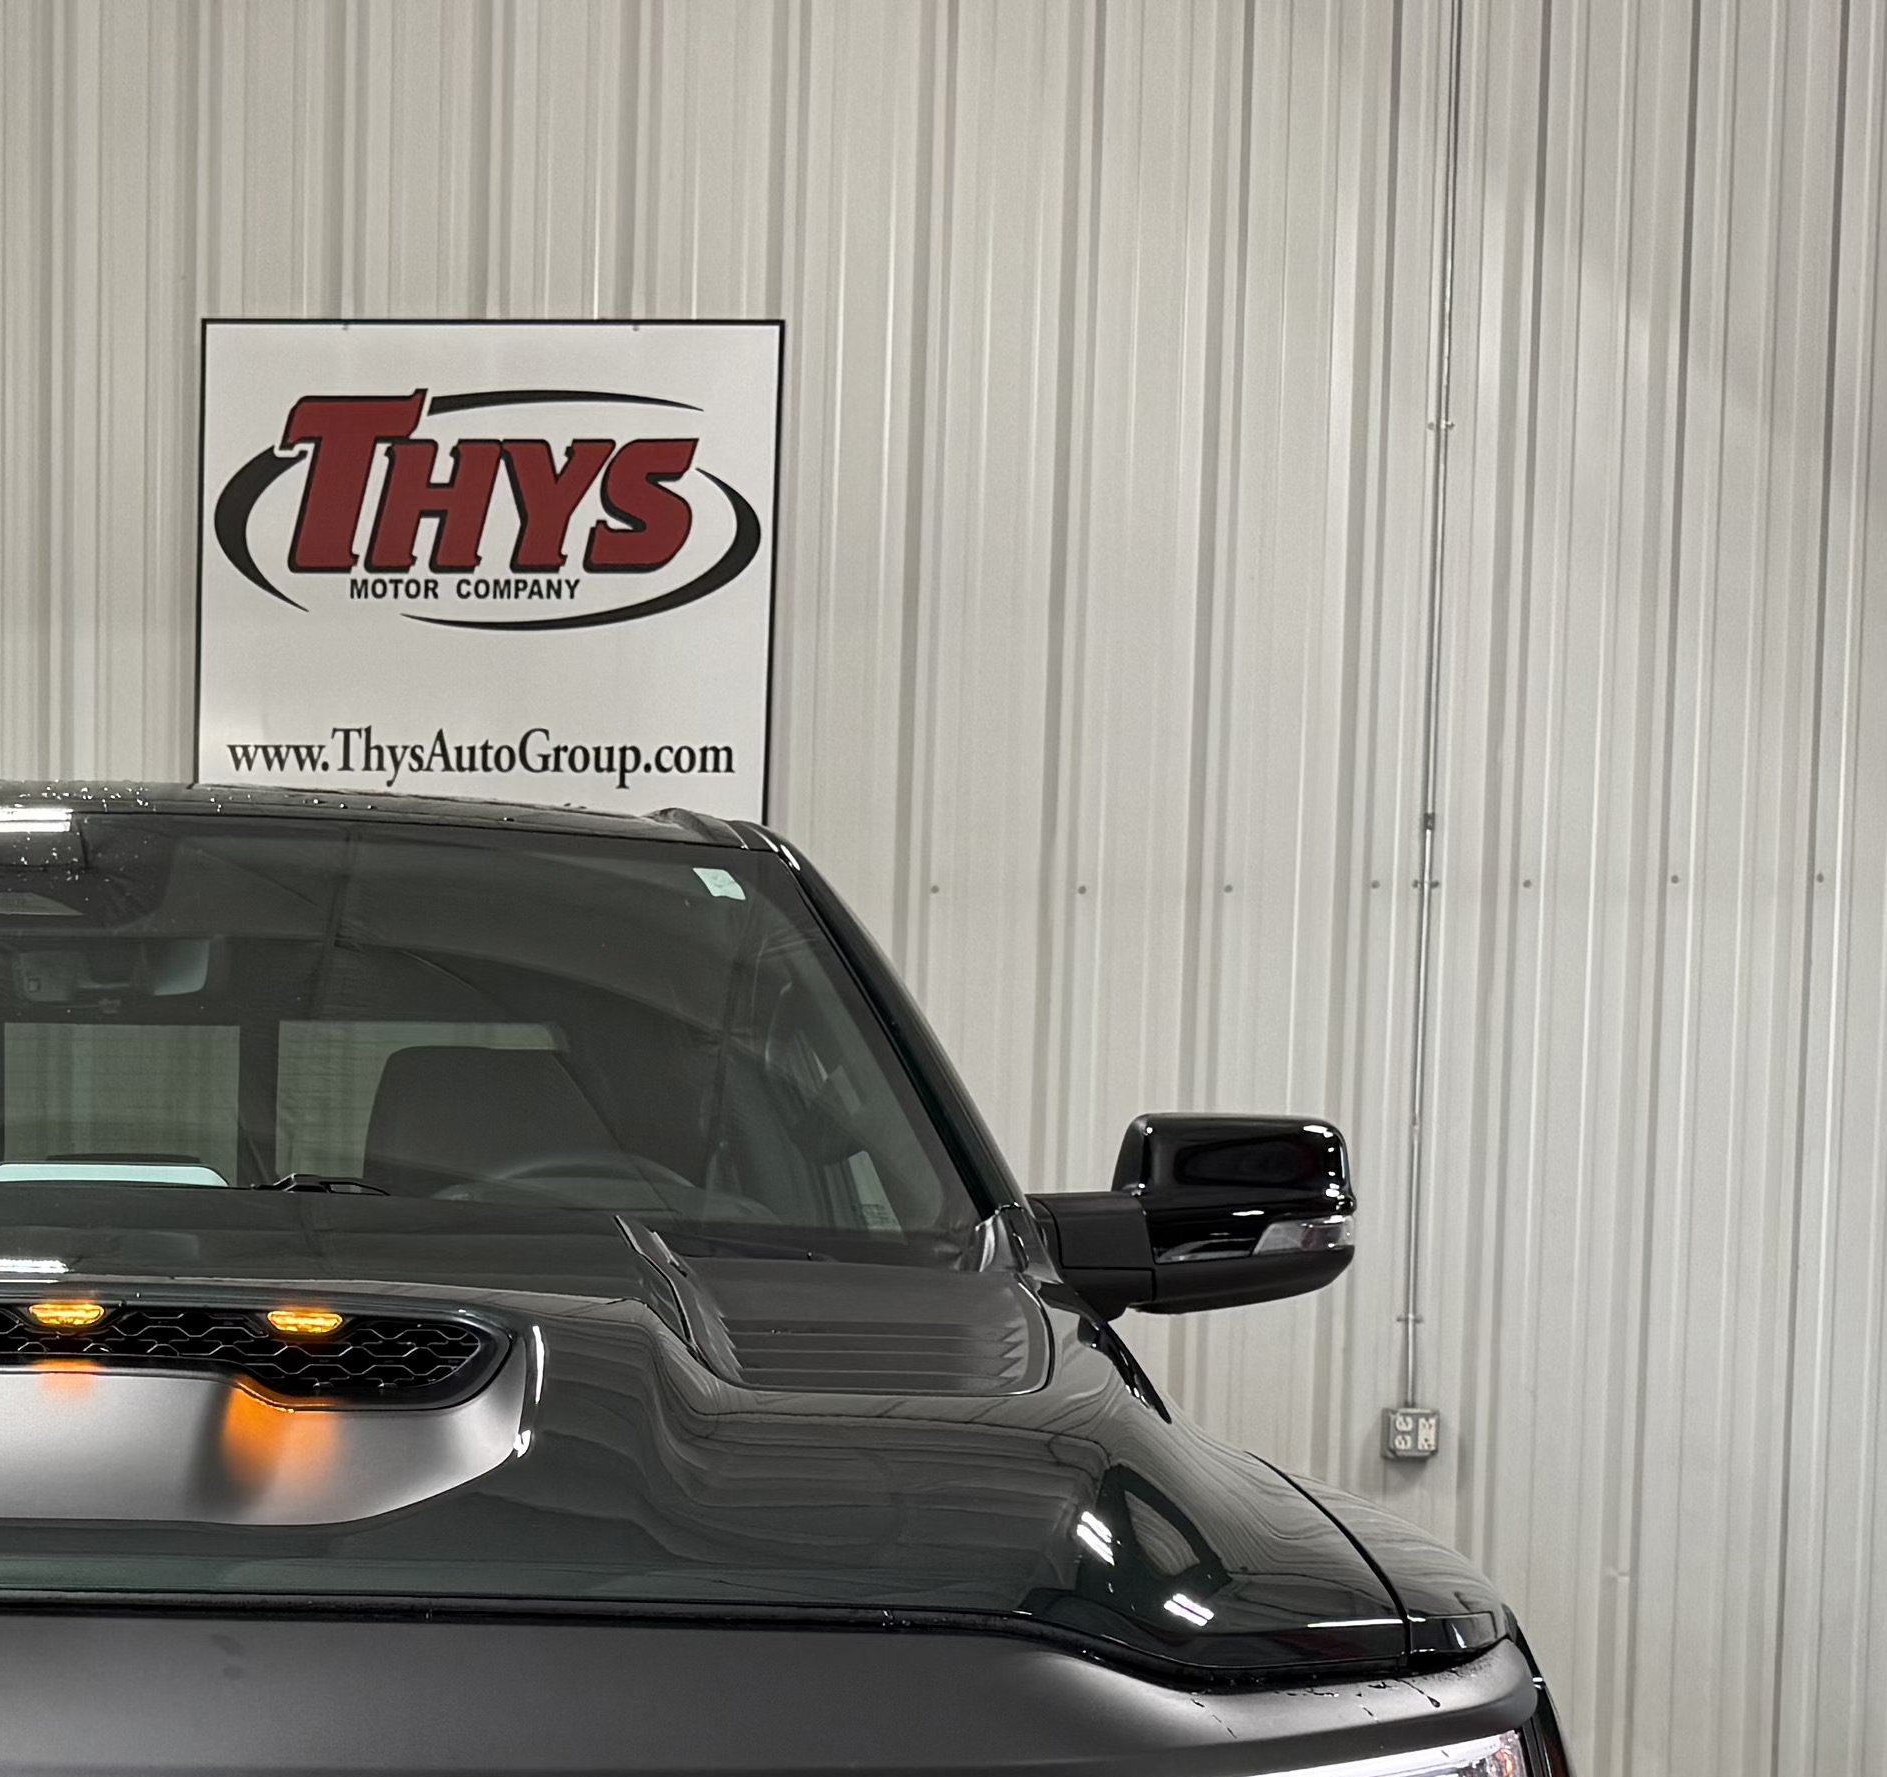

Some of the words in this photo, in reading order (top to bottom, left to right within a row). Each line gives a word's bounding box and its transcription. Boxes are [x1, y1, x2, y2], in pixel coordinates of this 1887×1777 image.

[281, 388, 699, 574] THYS
[349, 578, 439, 600] MOTOR
[456, 578, 581, 600] COMPANY
[227, 725, 736, 789] www.ThysAutoGroup.com
